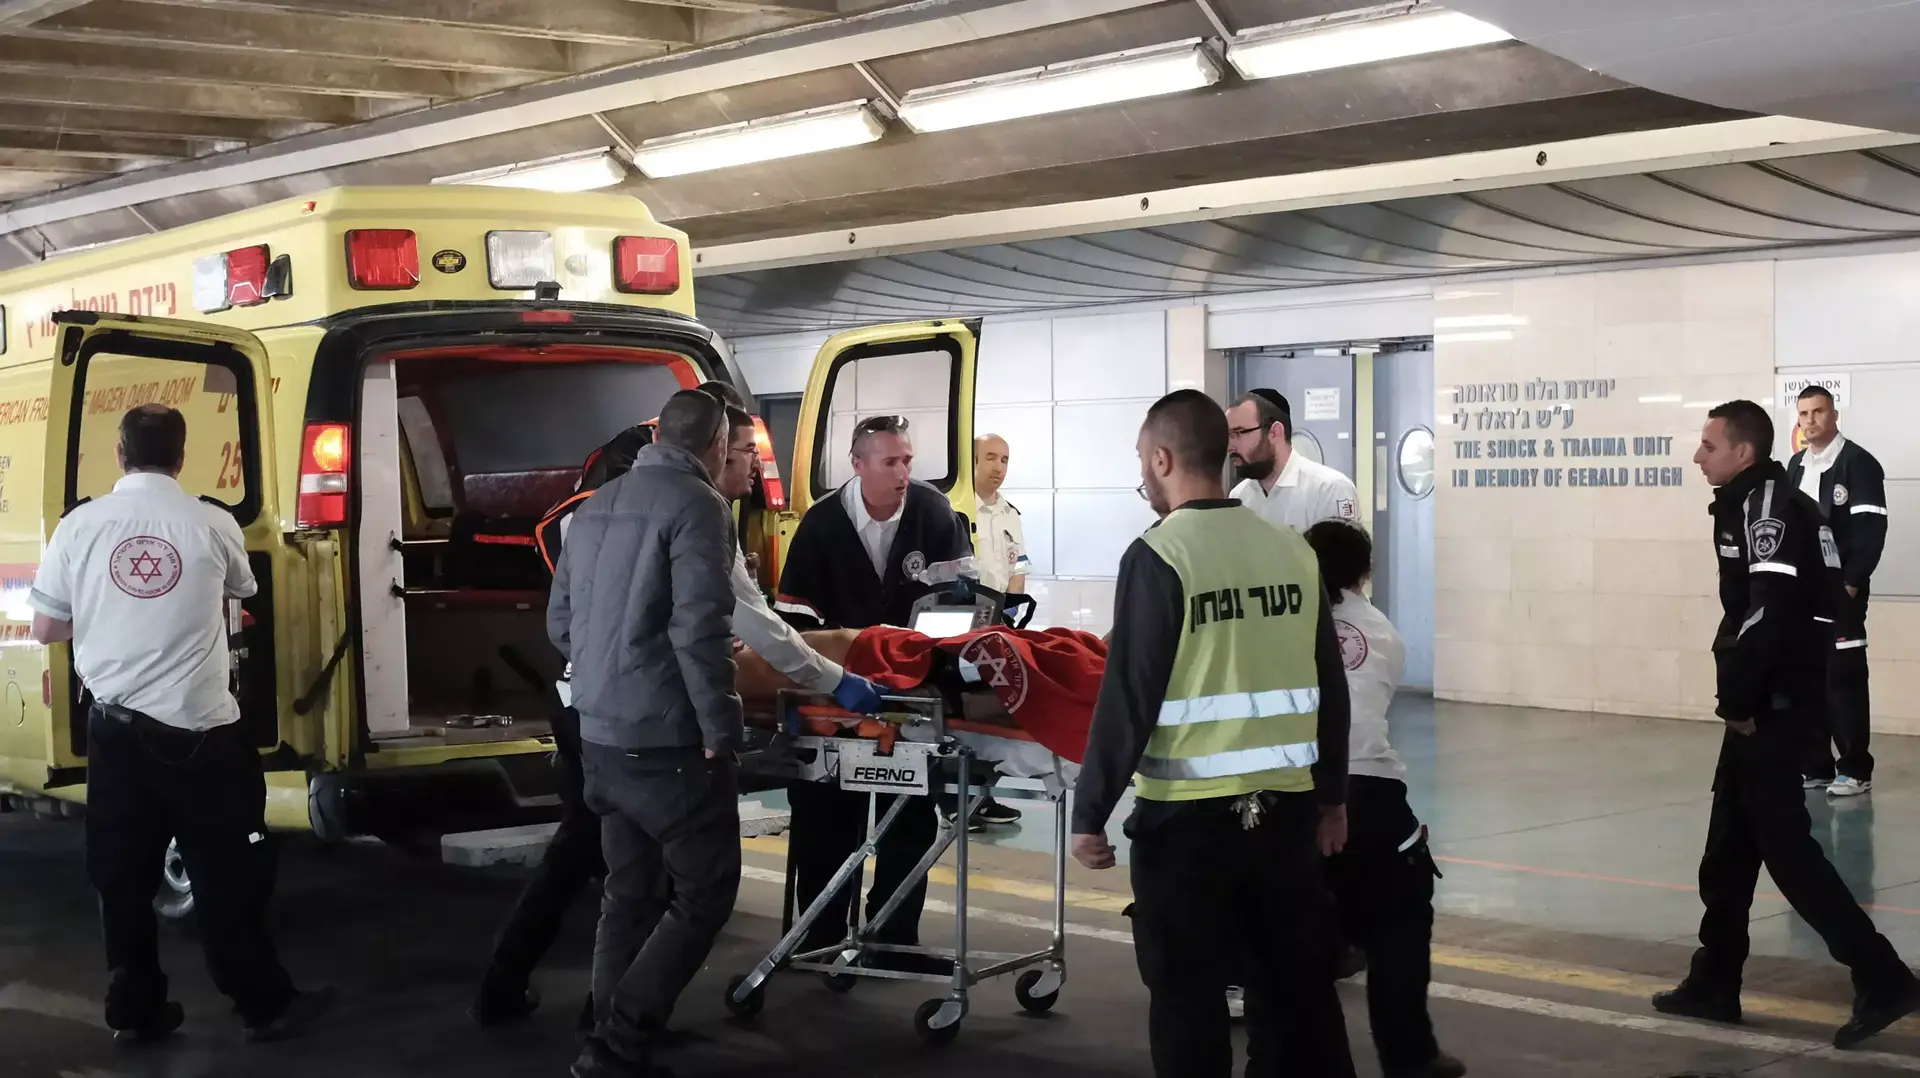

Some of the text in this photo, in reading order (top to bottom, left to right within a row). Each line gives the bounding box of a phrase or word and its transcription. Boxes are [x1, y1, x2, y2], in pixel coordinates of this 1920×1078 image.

[1453, 377, 1616, 403] יחידת הלם טראומה
[1454, 436, 1673, 459] THE SHOCK & TRAUMA UNIT
[1451, 467, 1683, 487] IN MEMORY OF GERALD LEIGH
[1248, 584, 1303, 617] סער
[854, 767, 915, 782] FERNO
